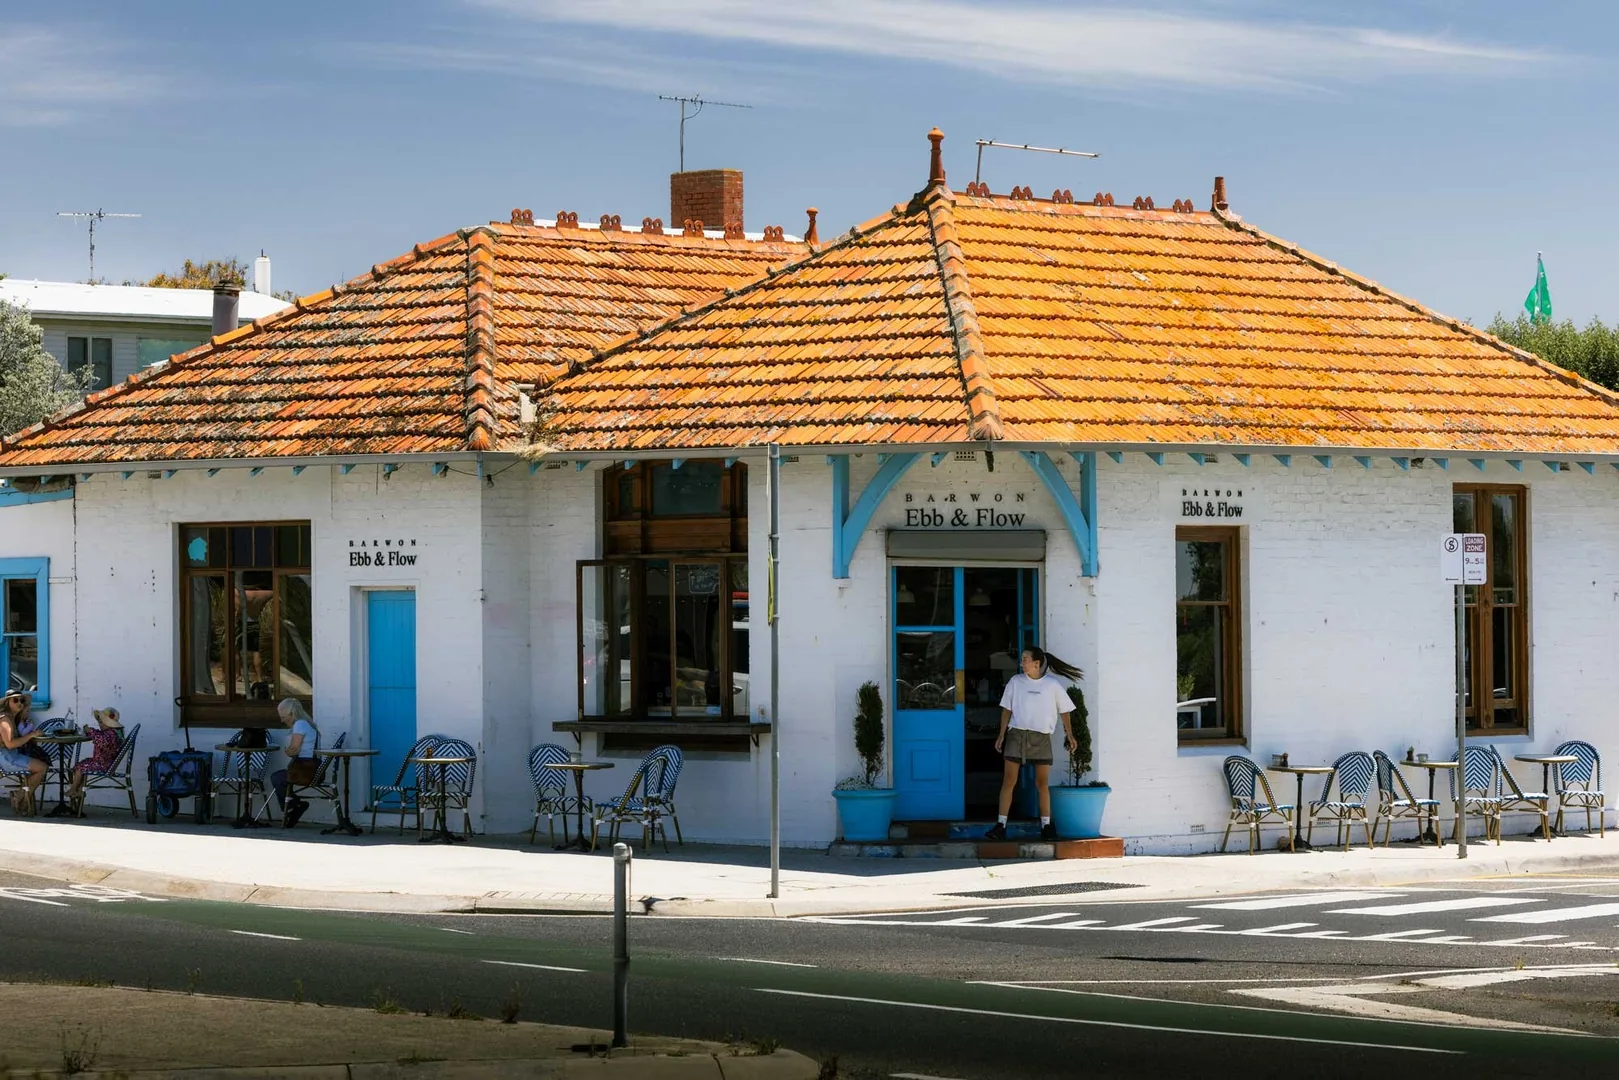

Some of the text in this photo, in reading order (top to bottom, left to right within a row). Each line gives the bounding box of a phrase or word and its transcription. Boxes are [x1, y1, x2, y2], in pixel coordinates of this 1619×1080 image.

[1182, 488, 1243, 497] BARWON
[905, 493, 1025, 503] BARWON
[1182, 501, 1243, 518] Ebb & Flow
[904, 508, 1026, 527] Ebb & Flow
[349, 539, 417, 548] BARWON
[1466, 544, 1484, 552] ZONE
[349, 550, 417, 567] Ebb & Flow
